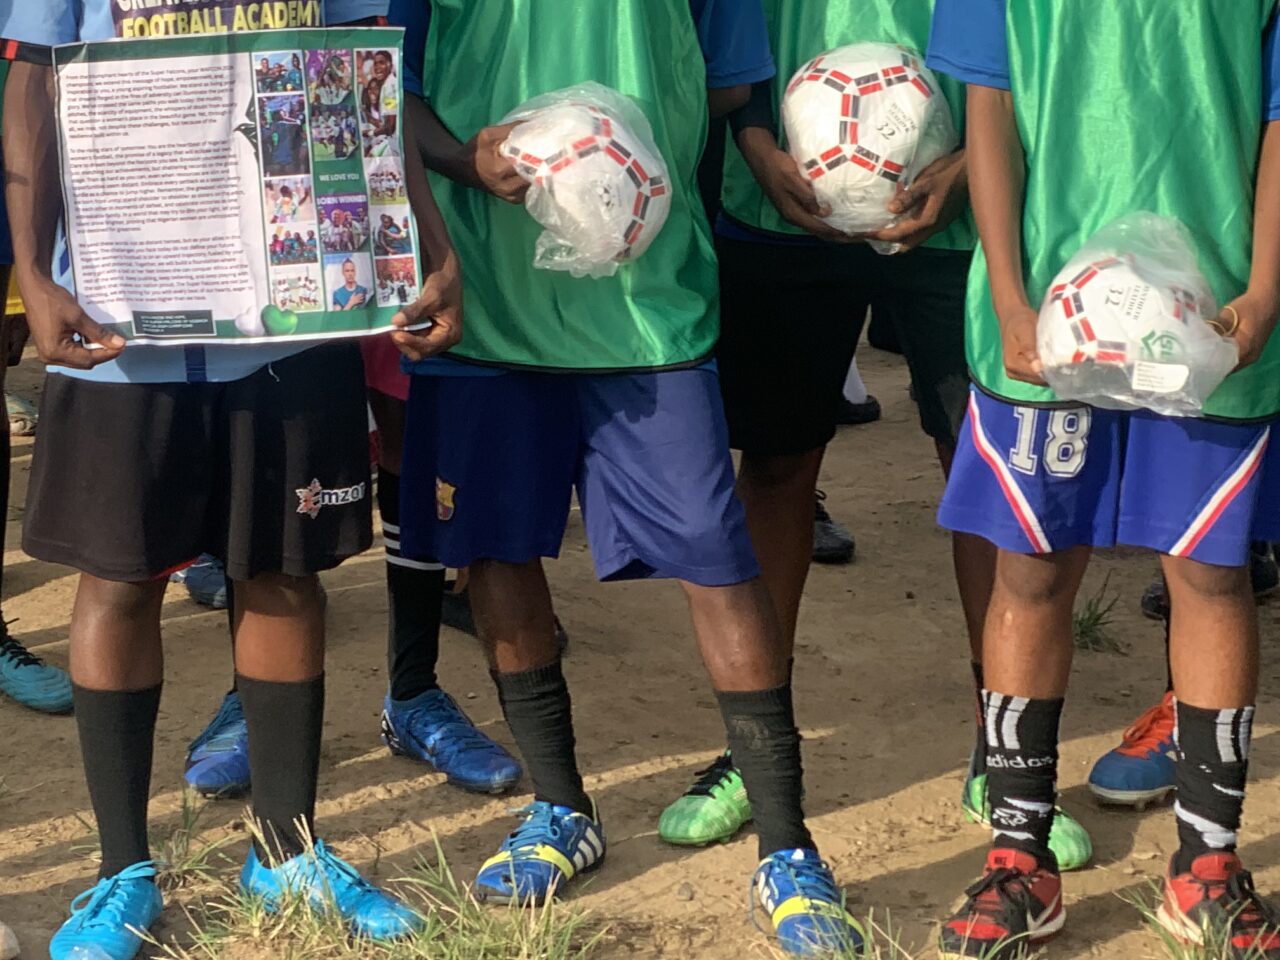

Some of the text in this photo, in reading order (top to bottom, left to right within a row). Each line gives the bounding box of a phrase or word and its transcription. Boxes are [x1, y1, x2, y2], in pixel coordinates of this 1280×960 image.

[122, 0, 321, 38] FOOTBALL ACADEMY
[330, 173, 346, 181] LOVE
[1008, 406, 1092, 478] 18
